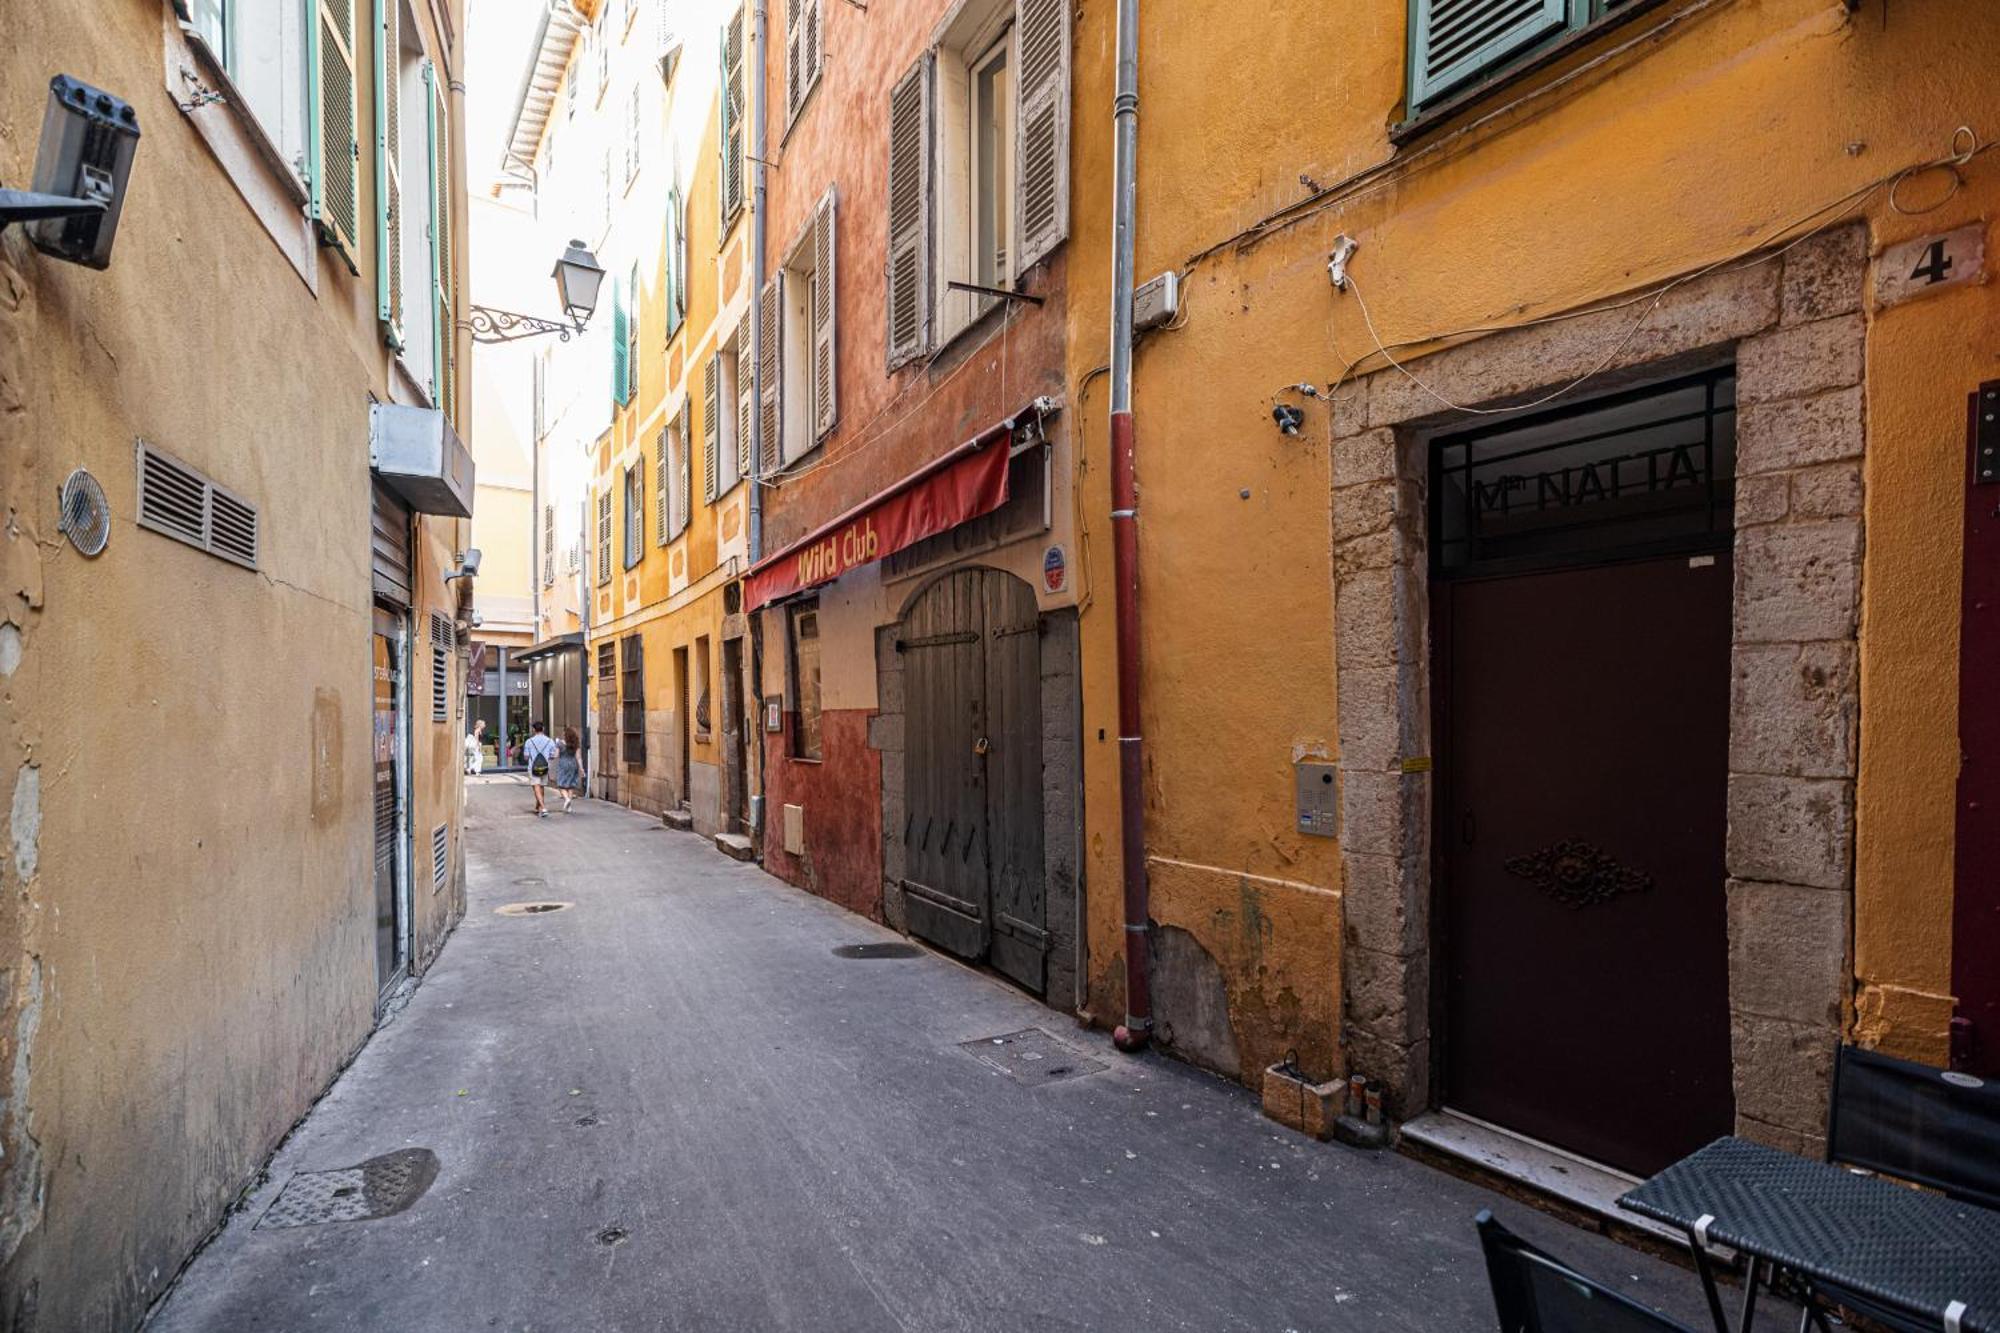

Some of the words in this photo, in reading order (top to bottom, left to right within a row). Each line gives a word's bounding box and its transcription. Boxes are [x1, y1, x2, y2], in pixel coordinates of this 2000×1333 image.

[1909, 238, 1952, 286] 4
[1537, 445, 1698, 511] NATTA
[798, 536, 836, 586] Wild
[843, 517, 878, 566] Club
